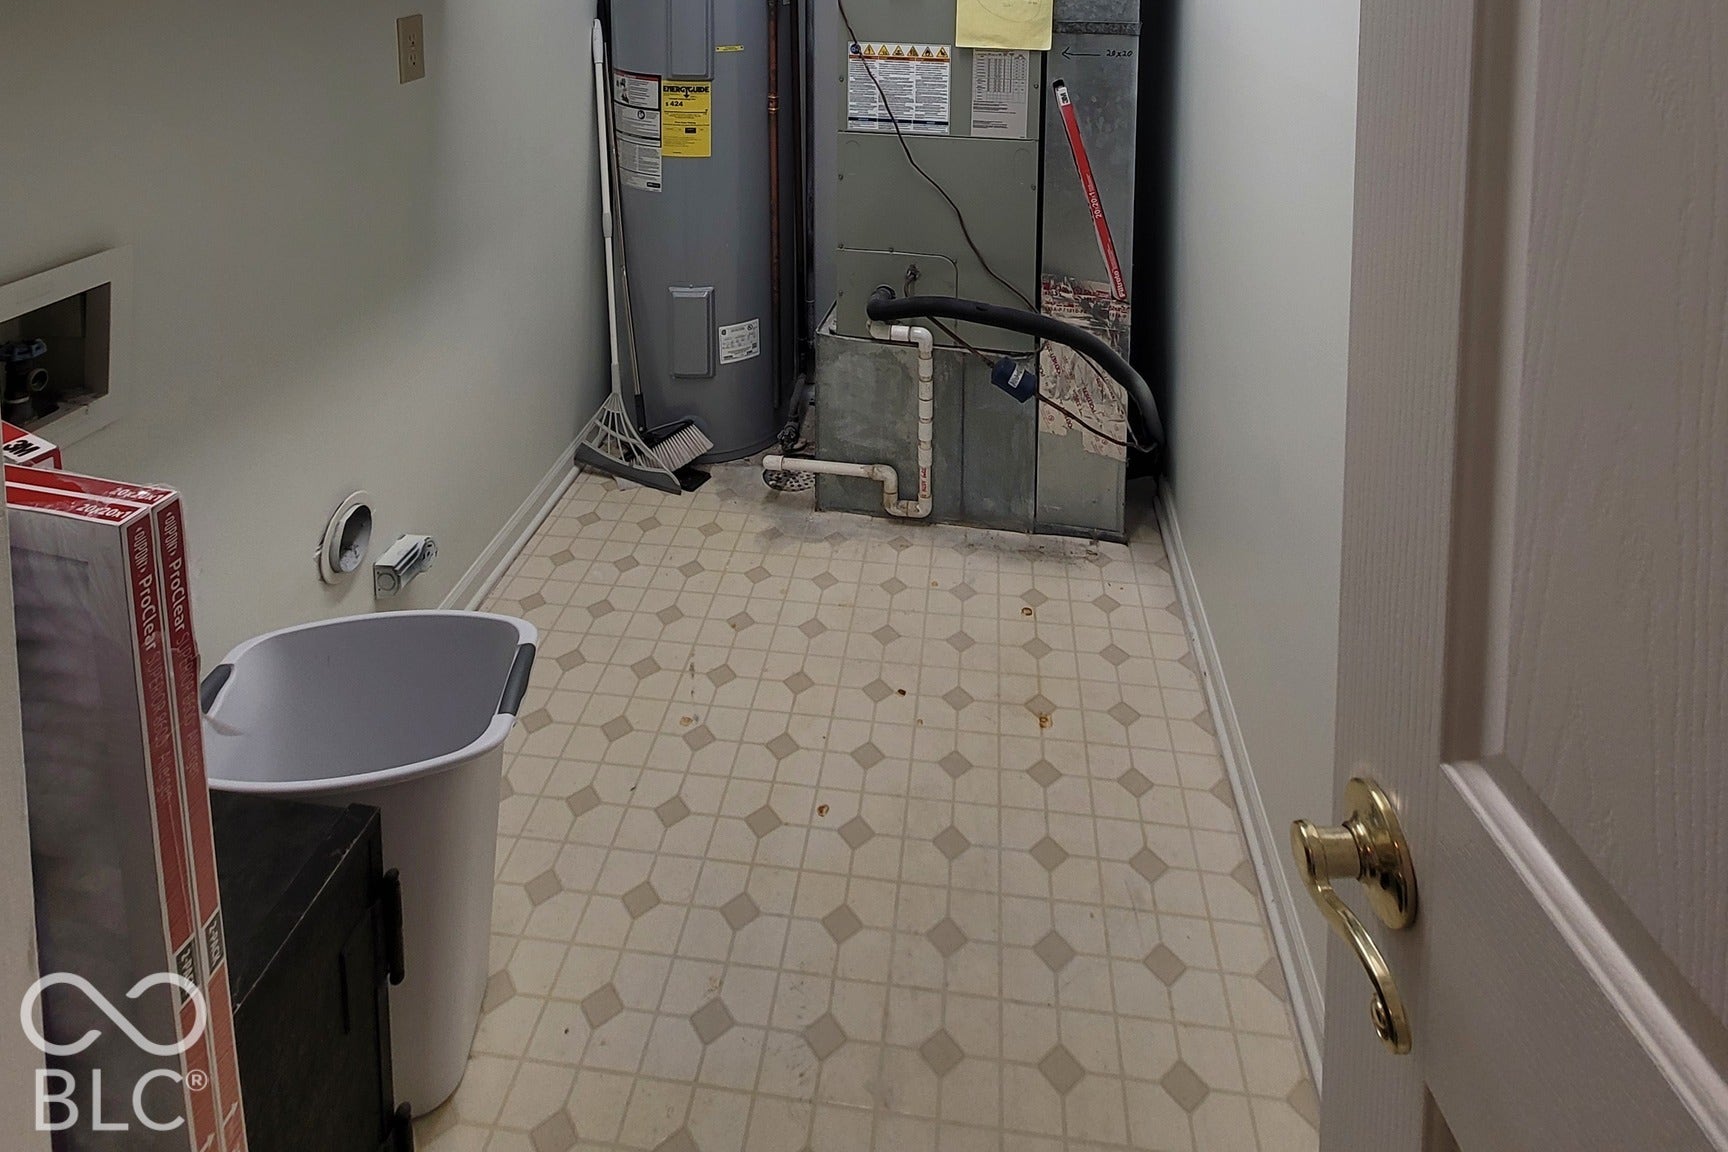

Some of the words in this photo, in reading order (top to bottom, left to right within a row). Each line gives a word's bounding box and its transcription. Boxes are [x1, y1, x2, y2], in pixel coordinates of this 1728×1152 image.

[3, 439, 41, 457] 3M
[76, 503, 134, 519] 20x20x1
[139, 574, 158, 651] ProClear
[168, 557, 187, 632] ProClear
[207, 919, 222, 966] 2-PACK
